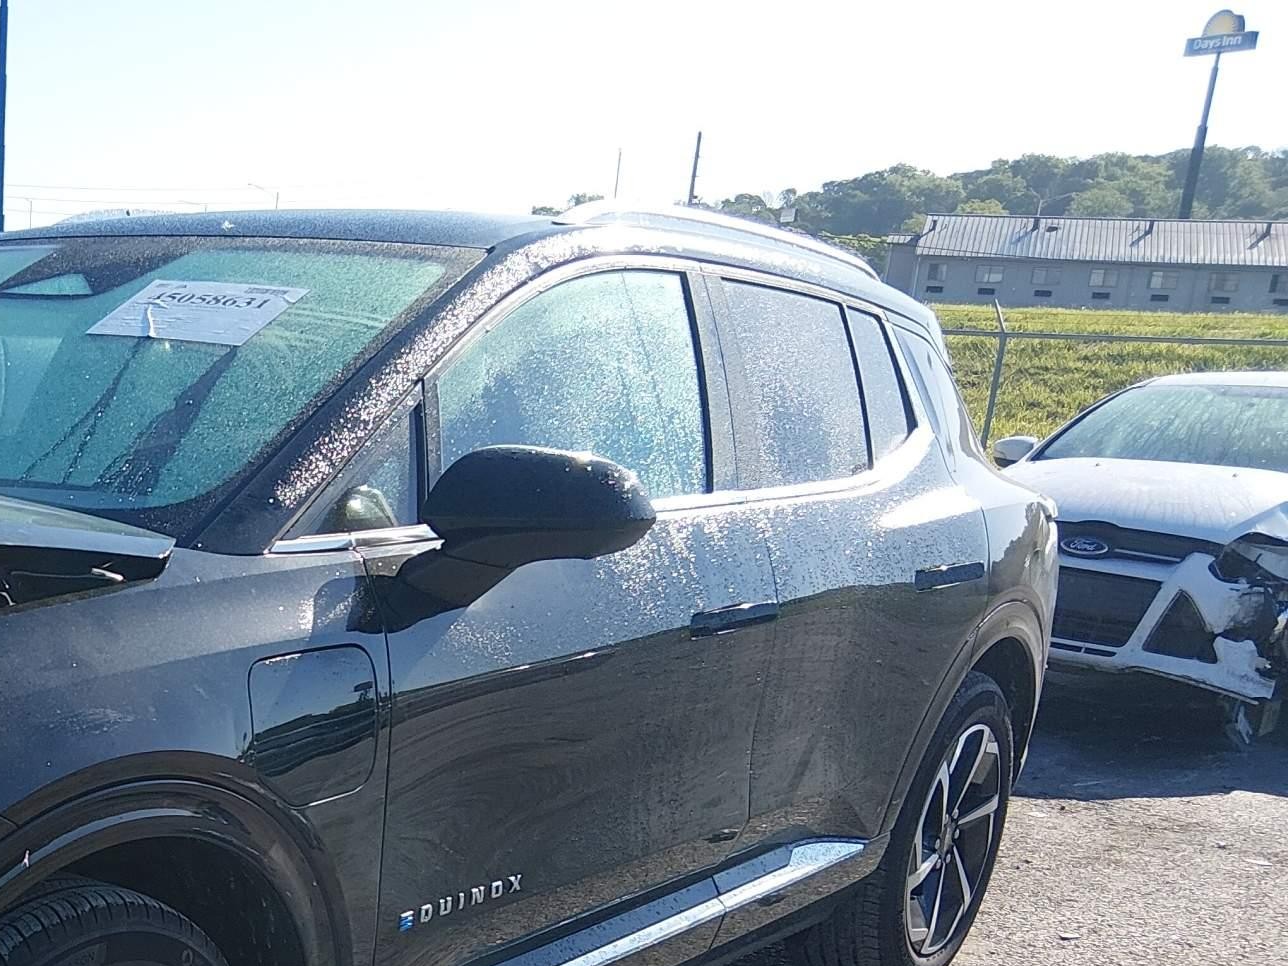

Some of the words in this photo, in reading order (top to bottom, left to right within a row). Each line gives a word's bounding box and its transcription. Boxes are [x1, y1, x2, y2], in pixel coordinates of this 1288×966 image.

[1193, 38, 1222, 50] Days
[1223, 35, 1242, 46] Inn
[399, 874, 523, 933] EQUINOX
